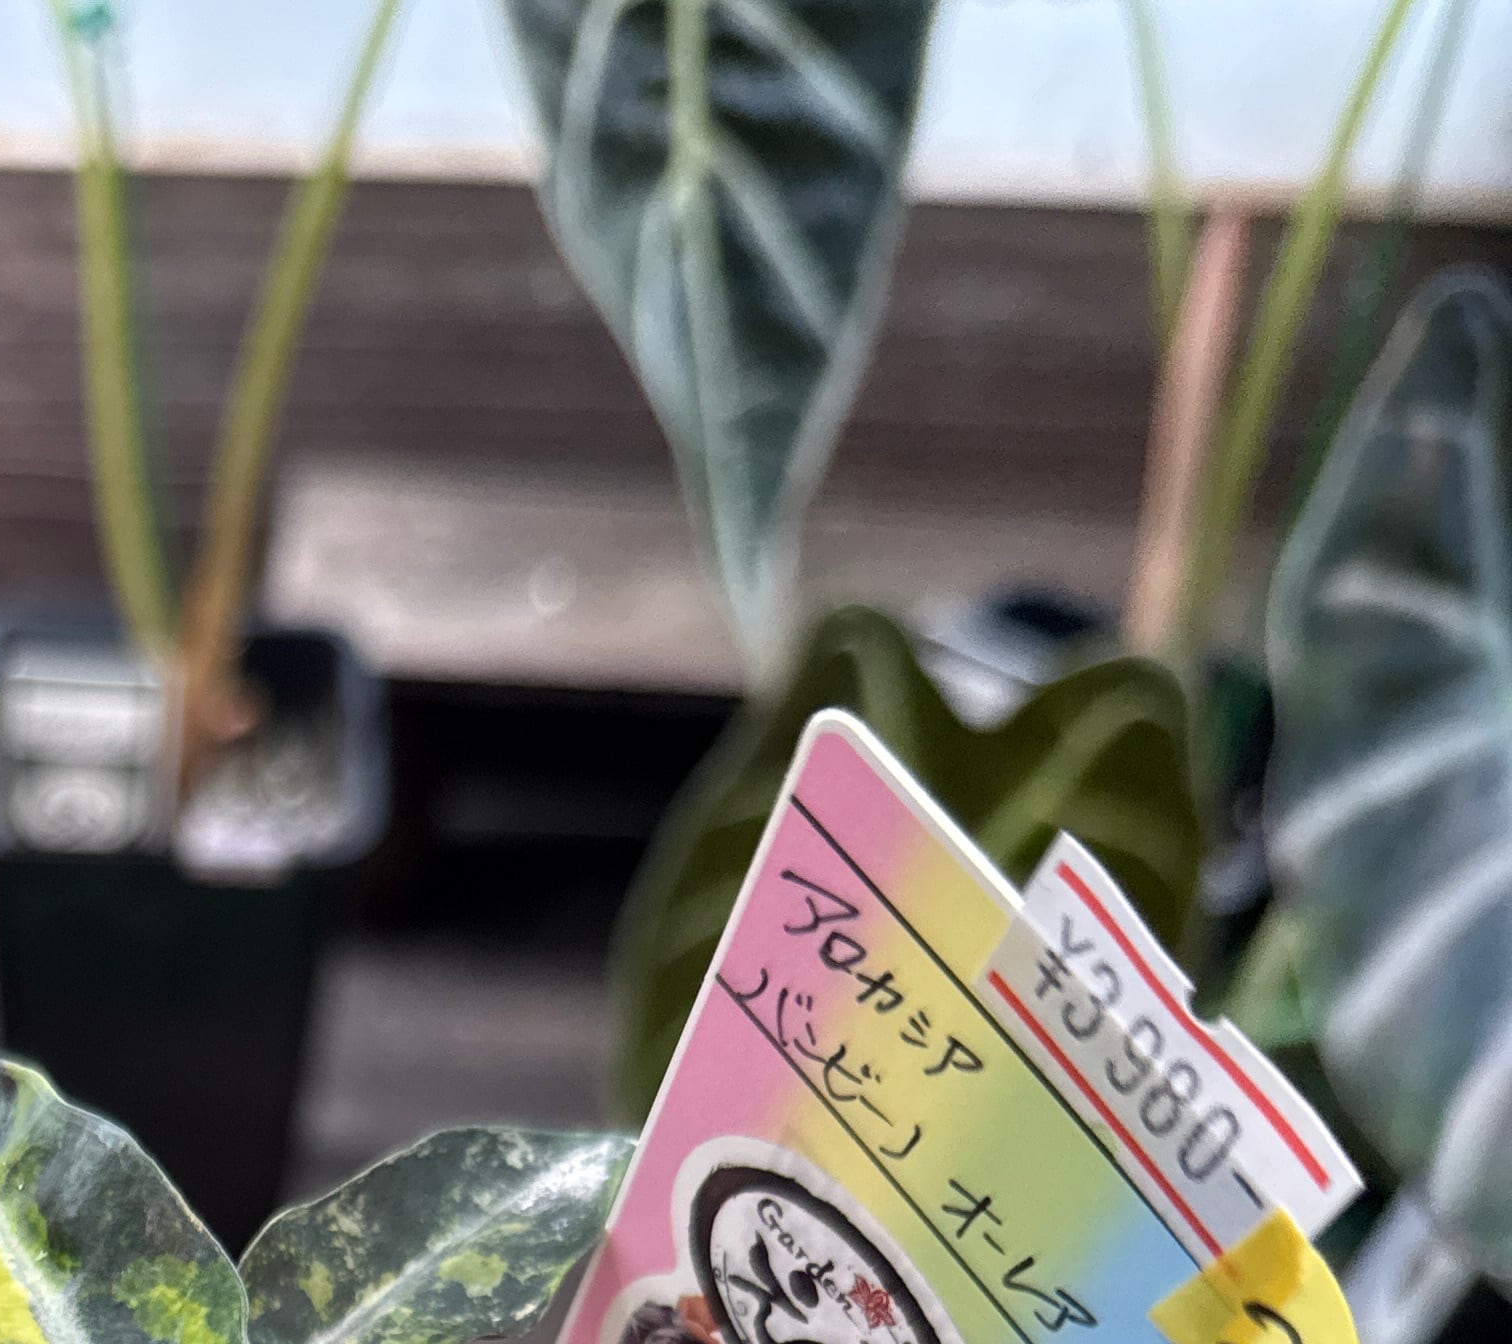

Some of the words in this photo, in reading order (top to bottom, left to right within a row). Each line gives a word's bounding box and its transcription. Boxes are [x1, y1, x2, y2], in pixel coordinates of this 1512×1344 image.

[780, 868, 985, 1077] アロカシア
[756, 1197, 854, 1313] Garden
[941, 1177, 1099, 1332] オーレア
